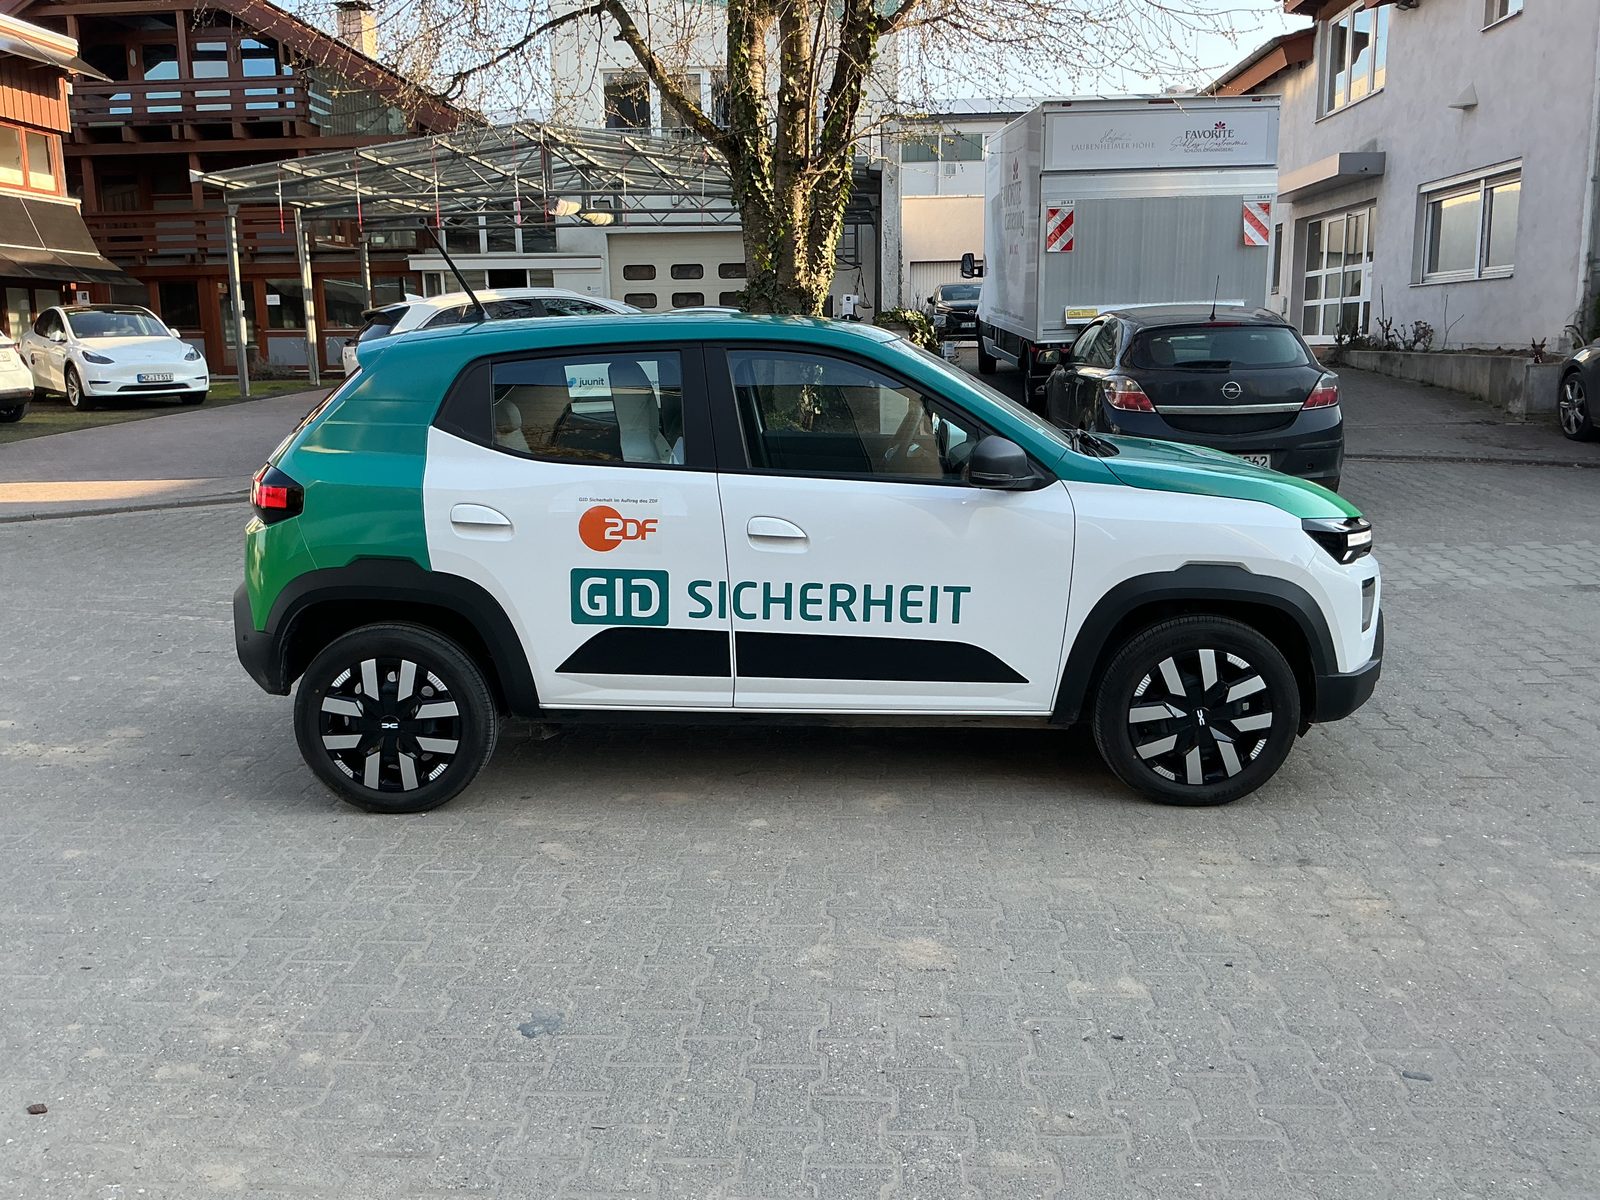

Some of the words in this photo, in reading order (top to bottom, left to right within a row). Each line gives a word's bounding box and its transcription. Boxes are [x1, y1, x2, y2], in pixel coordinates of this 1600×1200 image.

[1185, 129, 1235, 139] FAVORITE
[1071, 143, 1131, 151] LAUBENHEIMER
[579, 377, 605, 388] juunit
[603, 517, 659, 541] ZDF
[578, 576, 660, 617] GID
[687, 579, 972, 624] SICHERHEIT
